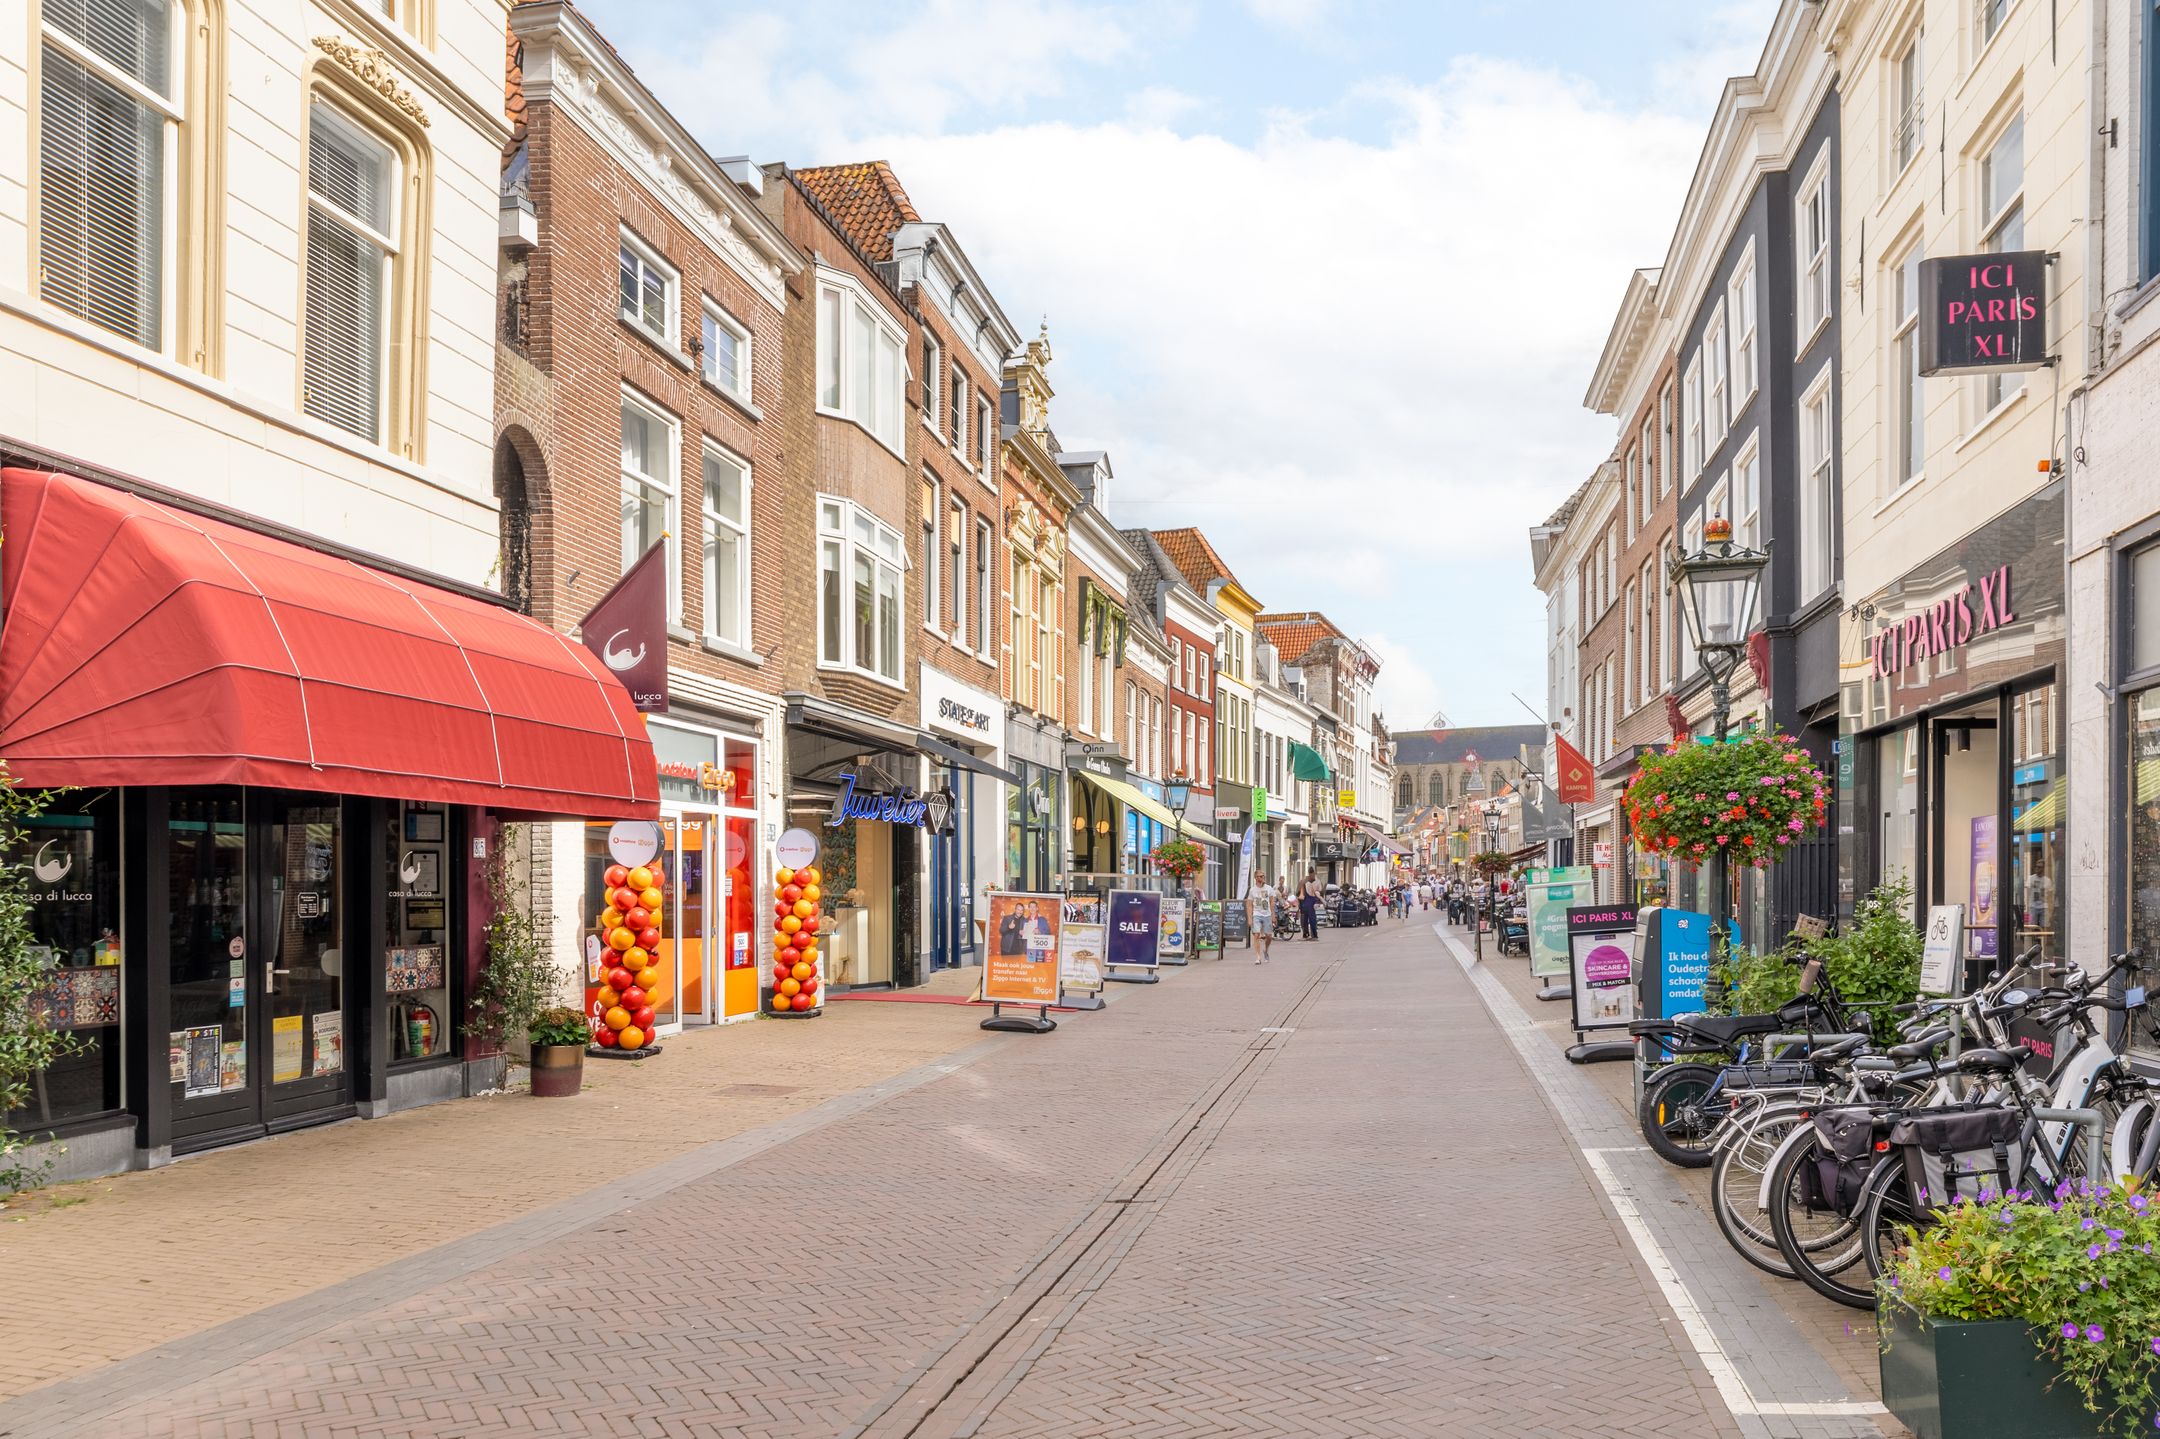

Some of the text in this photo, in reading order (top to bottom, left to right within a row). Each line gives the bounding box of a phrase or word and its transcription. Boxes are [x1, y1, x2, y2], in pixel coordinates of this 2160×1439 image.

[1970, 264, 2013, 289] ICI
[1948, 296, 2037, 325] PARIS
[1974, 334, 2011, 358] XL
[1871, 564, 2014, 682] ICI PARIS XL
[634, 691, 662, 701] lucca
[939, 697, 967, 725] STATE
[974, 711, 991, 732] ART
[1082, 744, 1105, 756] Qinn
[833, 773, 927, 828] Juwelier
[46, 889, 58, 901] di
[62, 889, 93, 901] lucca
[414, 889, 432, 897] lucca
[1572, 910, 1635, 924] ICI PARIS XL
[1119, 921, 1149, 933] SALE
[1668, 951, 1679, 962] Ik
[1681, 951, 1699, 961] hou
[2032, 1039, 2054, 1059] PARIS
